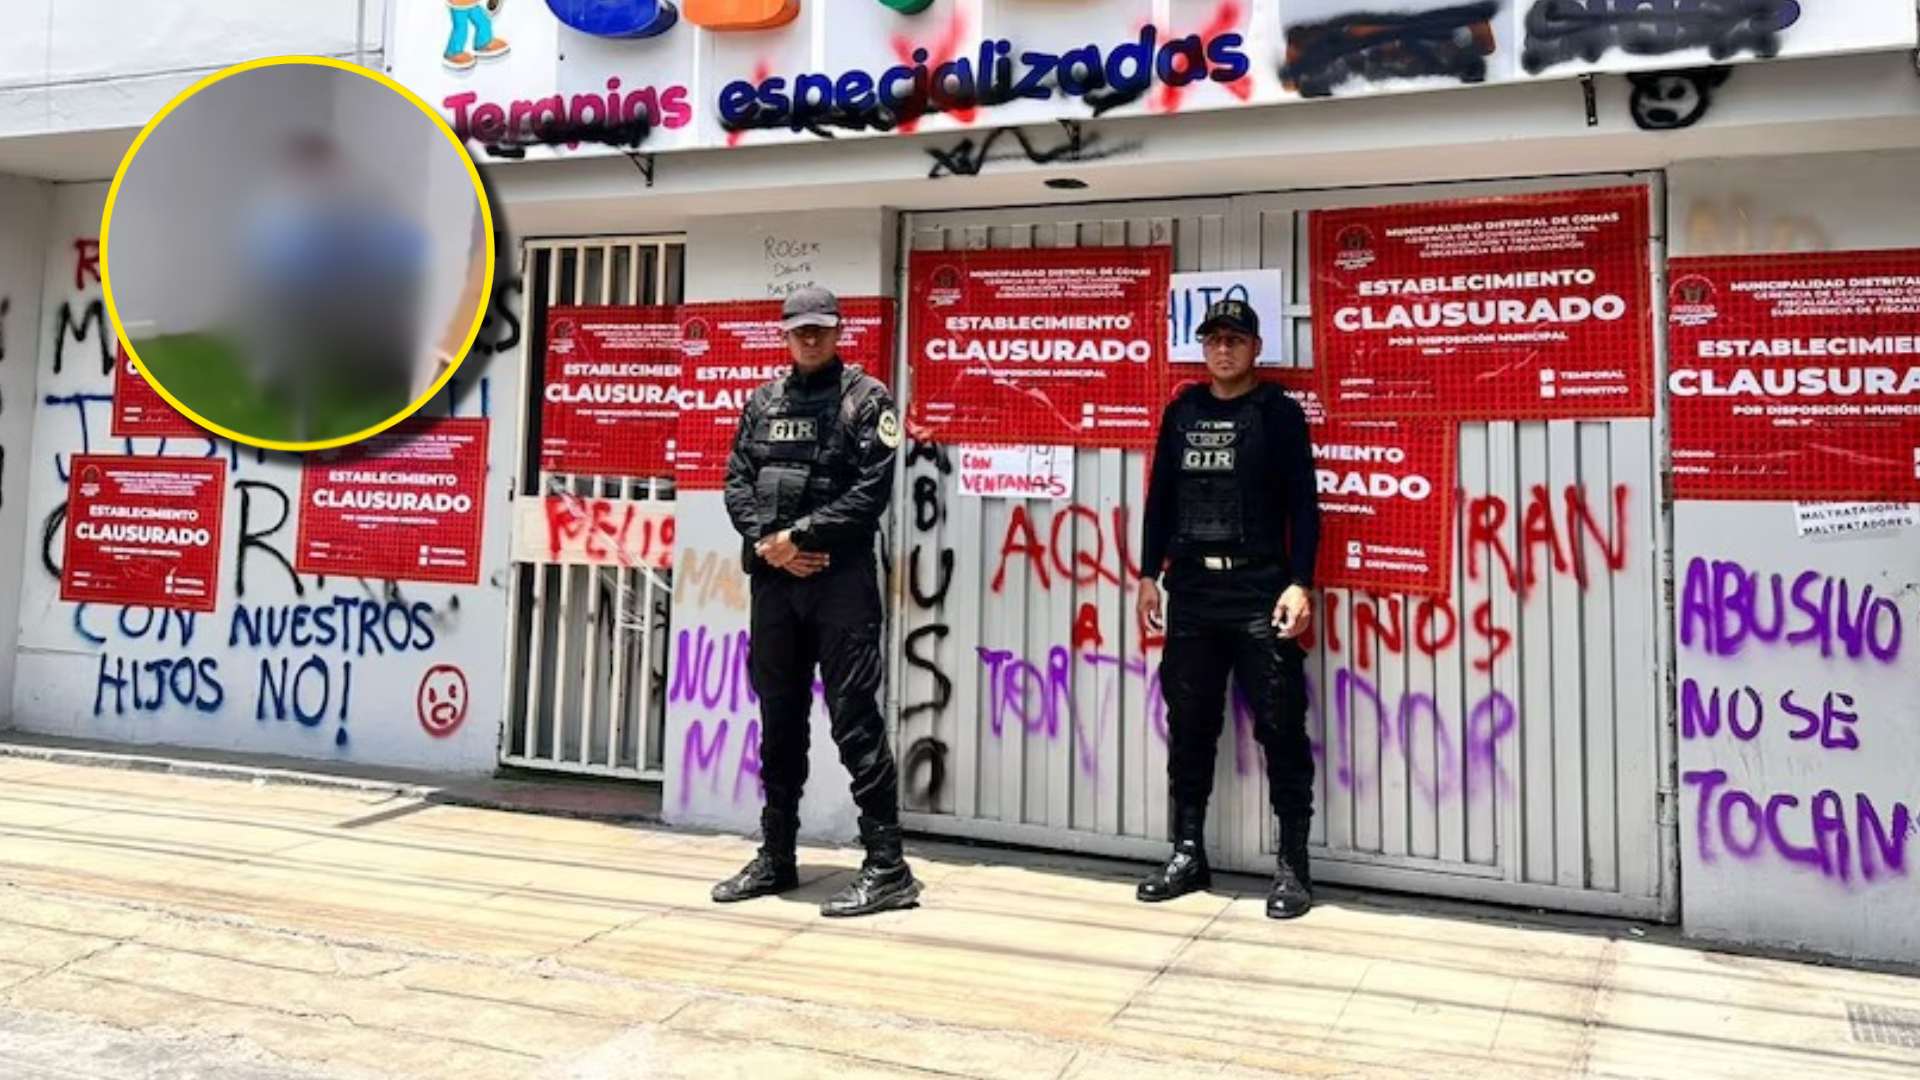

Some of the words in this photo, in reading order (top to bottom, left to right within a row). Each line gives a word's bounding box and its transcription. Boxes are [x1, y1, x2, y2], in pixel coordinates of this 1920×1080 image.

[443, 77, 692, 149] Terapias
[719, 24, 1250, 134] especializadas
[1386, 221, 1483, 237] MUNICIPALIDAD
[1485, 217, 1548, 230] DISTRITAL
[1552, 215, 1569, 225] DE
[1571, 212, 1619, 224] COMAS
[1358, 268, 1595, 297] ESTABLECIMIENTO
[1730, 279, 1845, 292] MUNICIPALIDAD
[945, 315, 1132, 331] ESTABLECIMIENTO
[1333, 294, 1625, 332] CLAUSURADO
[924, 339, 1151, 363] CLAUSURADO
[1388, 337, 1414, 346] POR
[1497, 331, 1568, 342] MUNICIPAL
[1560, 370, 1627, 380] TEMPORAL
[1732, 405, 1763, 416] POR
[1766, 403, 1861, 415] DISPOSICIÓN
[772, 420, 815, 441] GIR
[1185, 450, 1232, 469] GIR
[328, 470, 458, 487] ESTABLECIMIENTO
[962, 474, 1066, 496] VENTANAS
[89, 504, 199, 522] ESTABLECIMIENTO
[312, 488, 472, 513] CLAUSURADO
[75, 521, 210, 547] CLAUSURADO
[1680, 555, 1903, 665] ABUSIVO
[228, 595, 438, 656] NUESTROS
[669, 625, 758, 712] NUN
[94, 651, 225, 717] HIJOS
[256, 653, 353, 747] NO!
[1681, 677, 1764, 742] NO
[1780, 688, 1860, 750] SE
[1682, 768, 1910, 884] TOCAN
